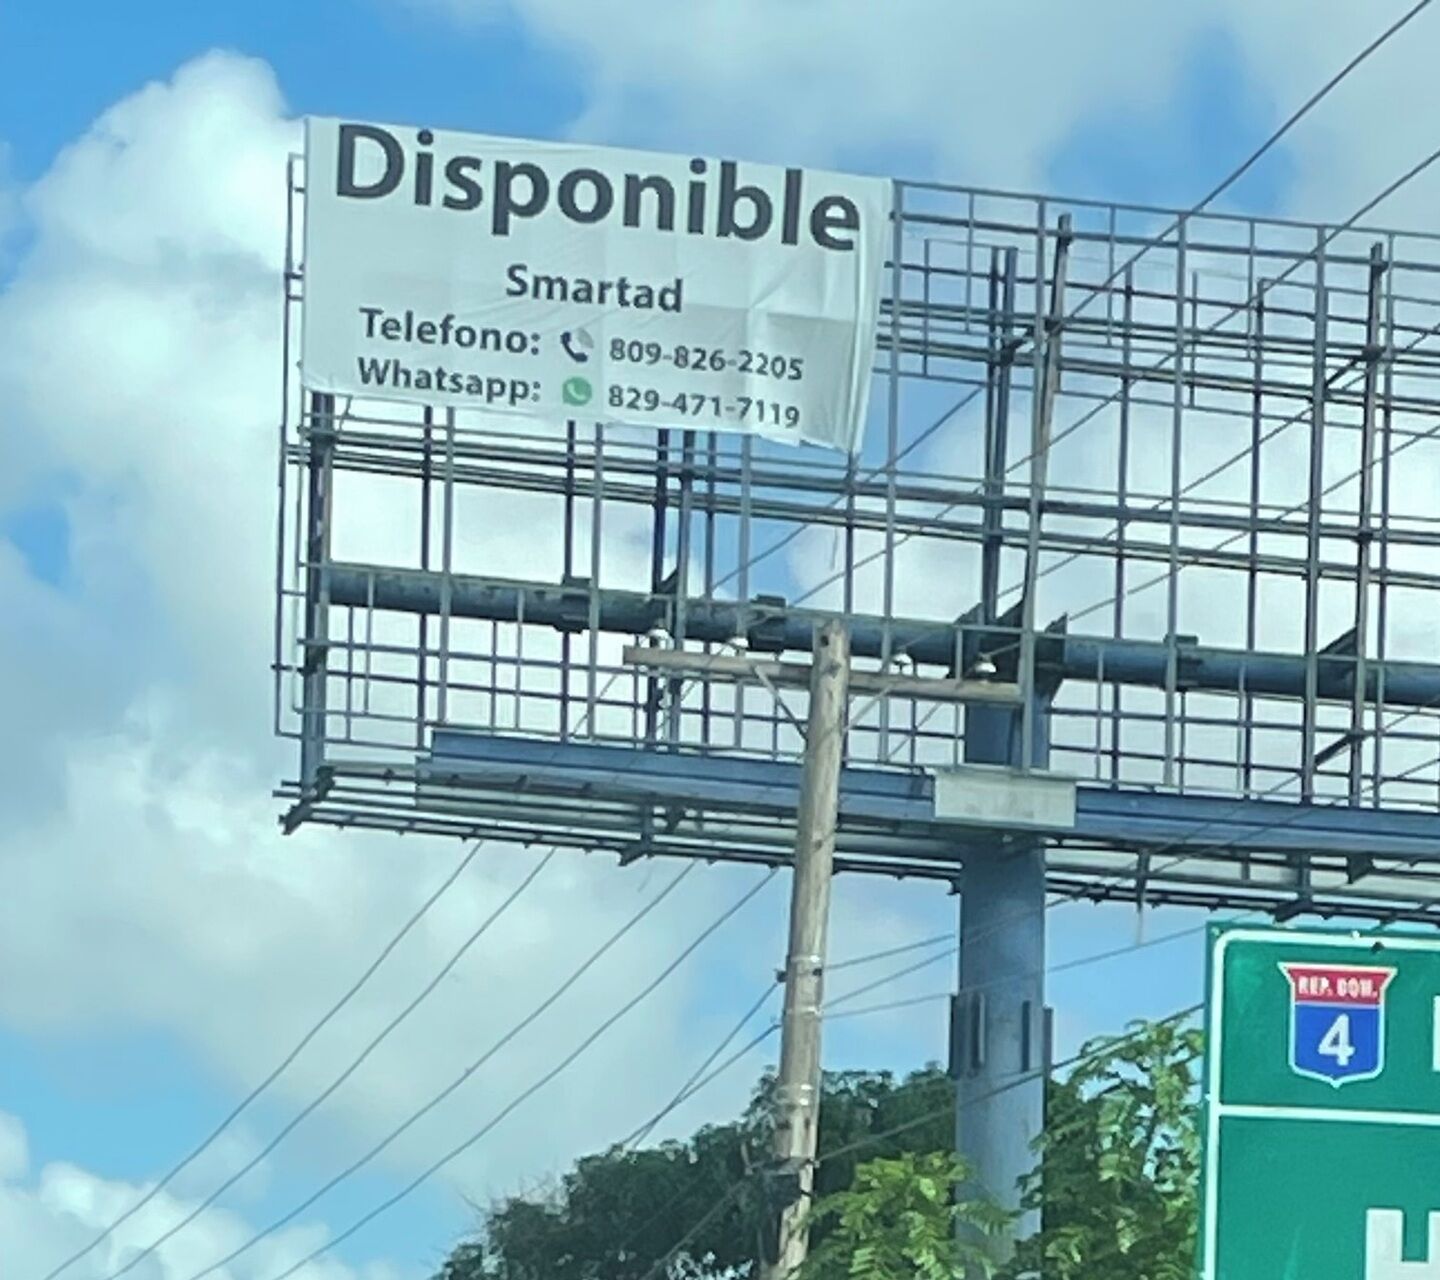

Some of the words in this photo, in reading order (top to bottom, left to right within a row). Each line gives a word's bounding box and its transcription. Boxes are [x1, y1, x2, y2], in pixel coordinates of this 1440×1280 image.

[336, 123, 861, 251] Disponible
[506, 263, 684, 313] Smartad
[359, 307, 540, 355] Telefono:
[609, 337, 804, 380] 809-826-2205
[358, 357, 541, 405] Whatsapp:
[608, 385, 801, 429] 829-471-7119
[1317, 1013, 1356, 1066] 4
